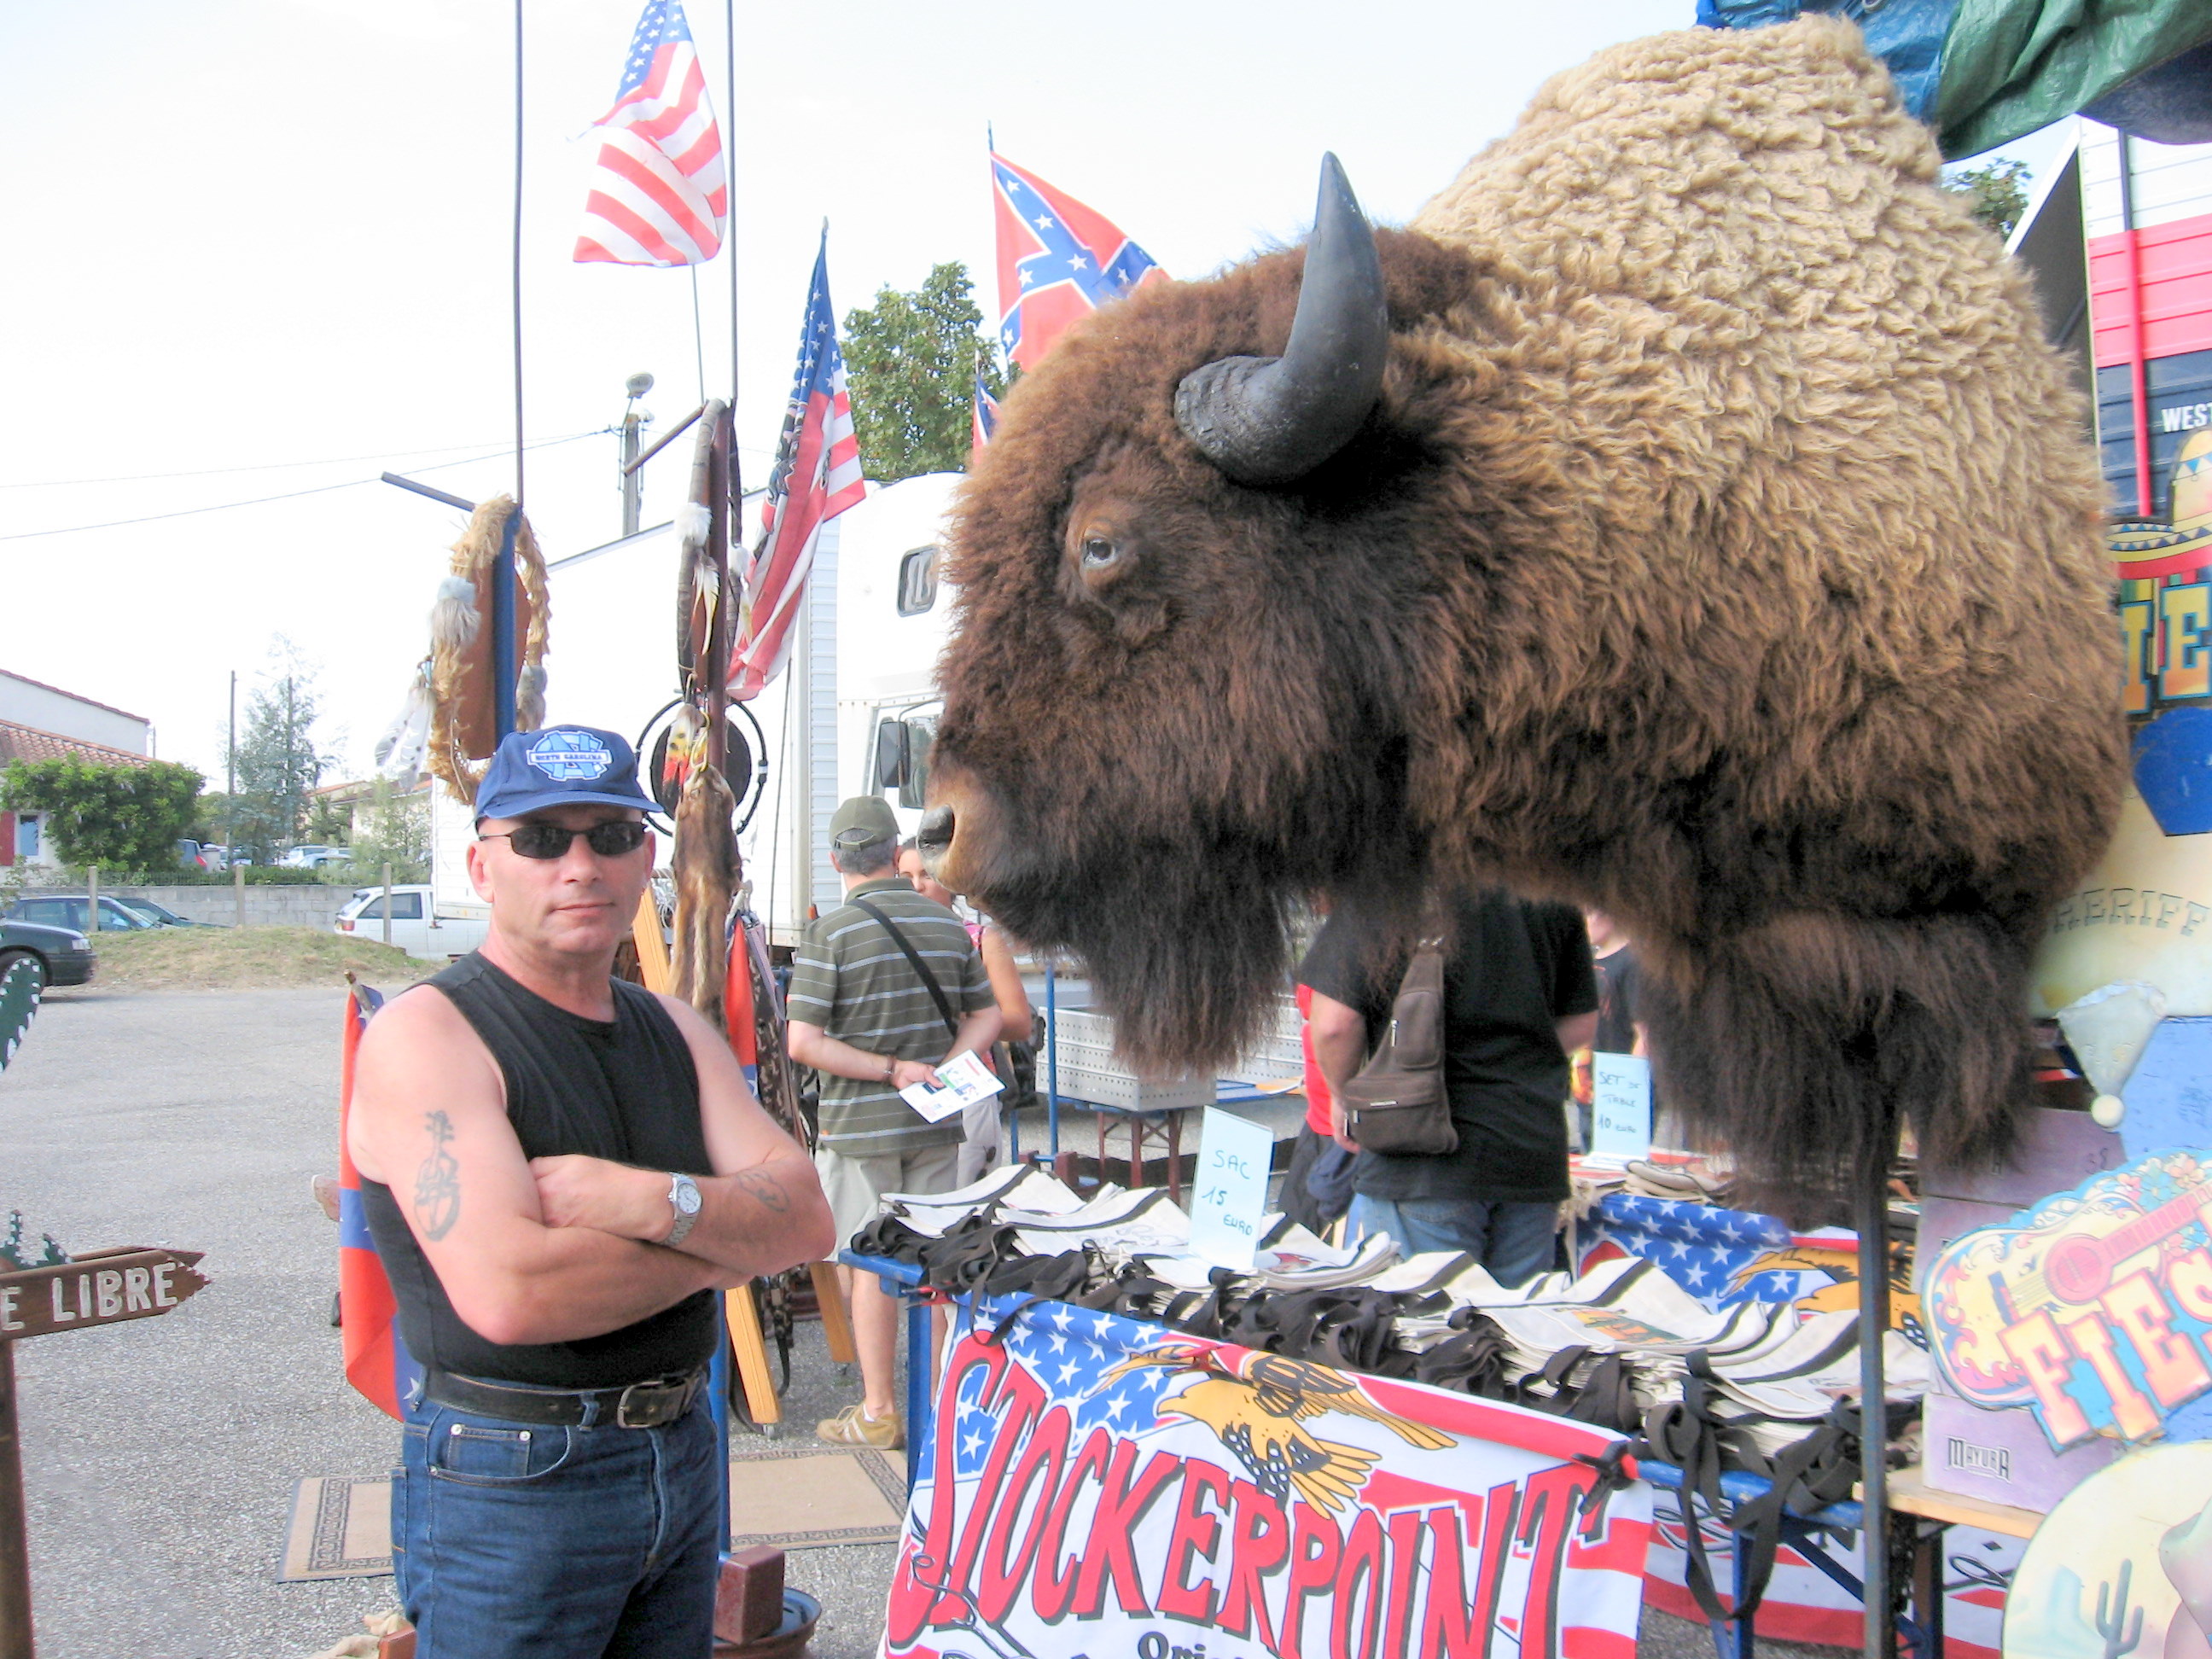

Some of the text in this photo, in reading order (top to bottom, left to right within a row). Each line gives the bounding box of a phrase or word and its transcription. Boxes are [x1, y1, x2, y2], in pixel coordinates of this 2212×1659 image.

[563, 752, 603, 761] CAROLINA
[2052, 888, 2211, 937] HERIFF
[1598, 1114, 1612, 1129] 10
[1213, 1149, 1251, 1180] SAC
[1202, 1185, 1229, 1207] 15
[1223, 1214, 1253, 1237] EURO
[51, 1261, 179, 1324] LIBRE
[1995, 1199, 2212, 1446] FIES
[884, 1328, 1613, 1659] STOCKERPOINT
